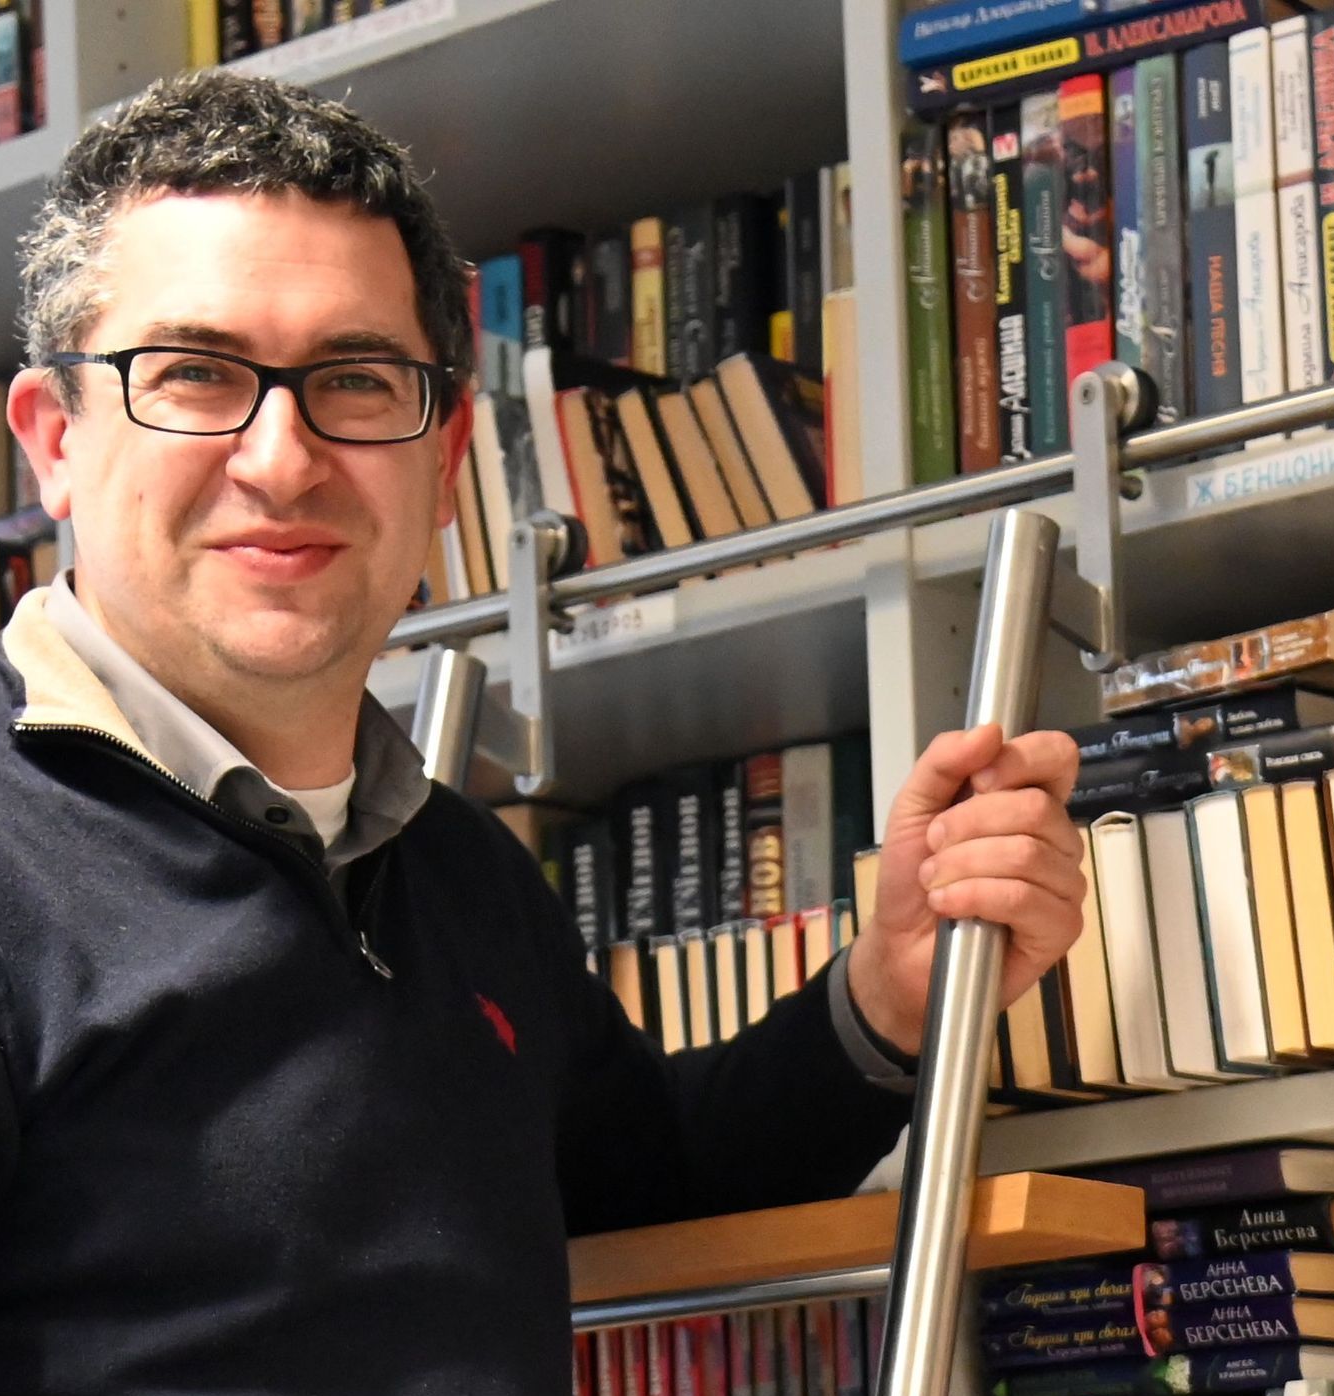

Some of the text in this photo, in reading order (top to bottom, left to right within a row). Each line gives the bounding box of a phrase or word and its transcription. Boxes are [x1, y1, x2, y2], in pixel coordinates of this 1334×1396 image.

[1208, 255, 1227, 376] НАША ПЕСНЯ
[1240, 1209, 1286, 1228] Анна
[1214, 1224, 1318, 1250] Берсенева
[1206, 1260, 1247, 1277] АННА
[1180, 1276, 1283, 1302] БЕРСЕНЕВА
[1211, 1305, 1251, 1323] АННА
[1185, 1320, 1288, 1344] БЕРСЕНЕВА
